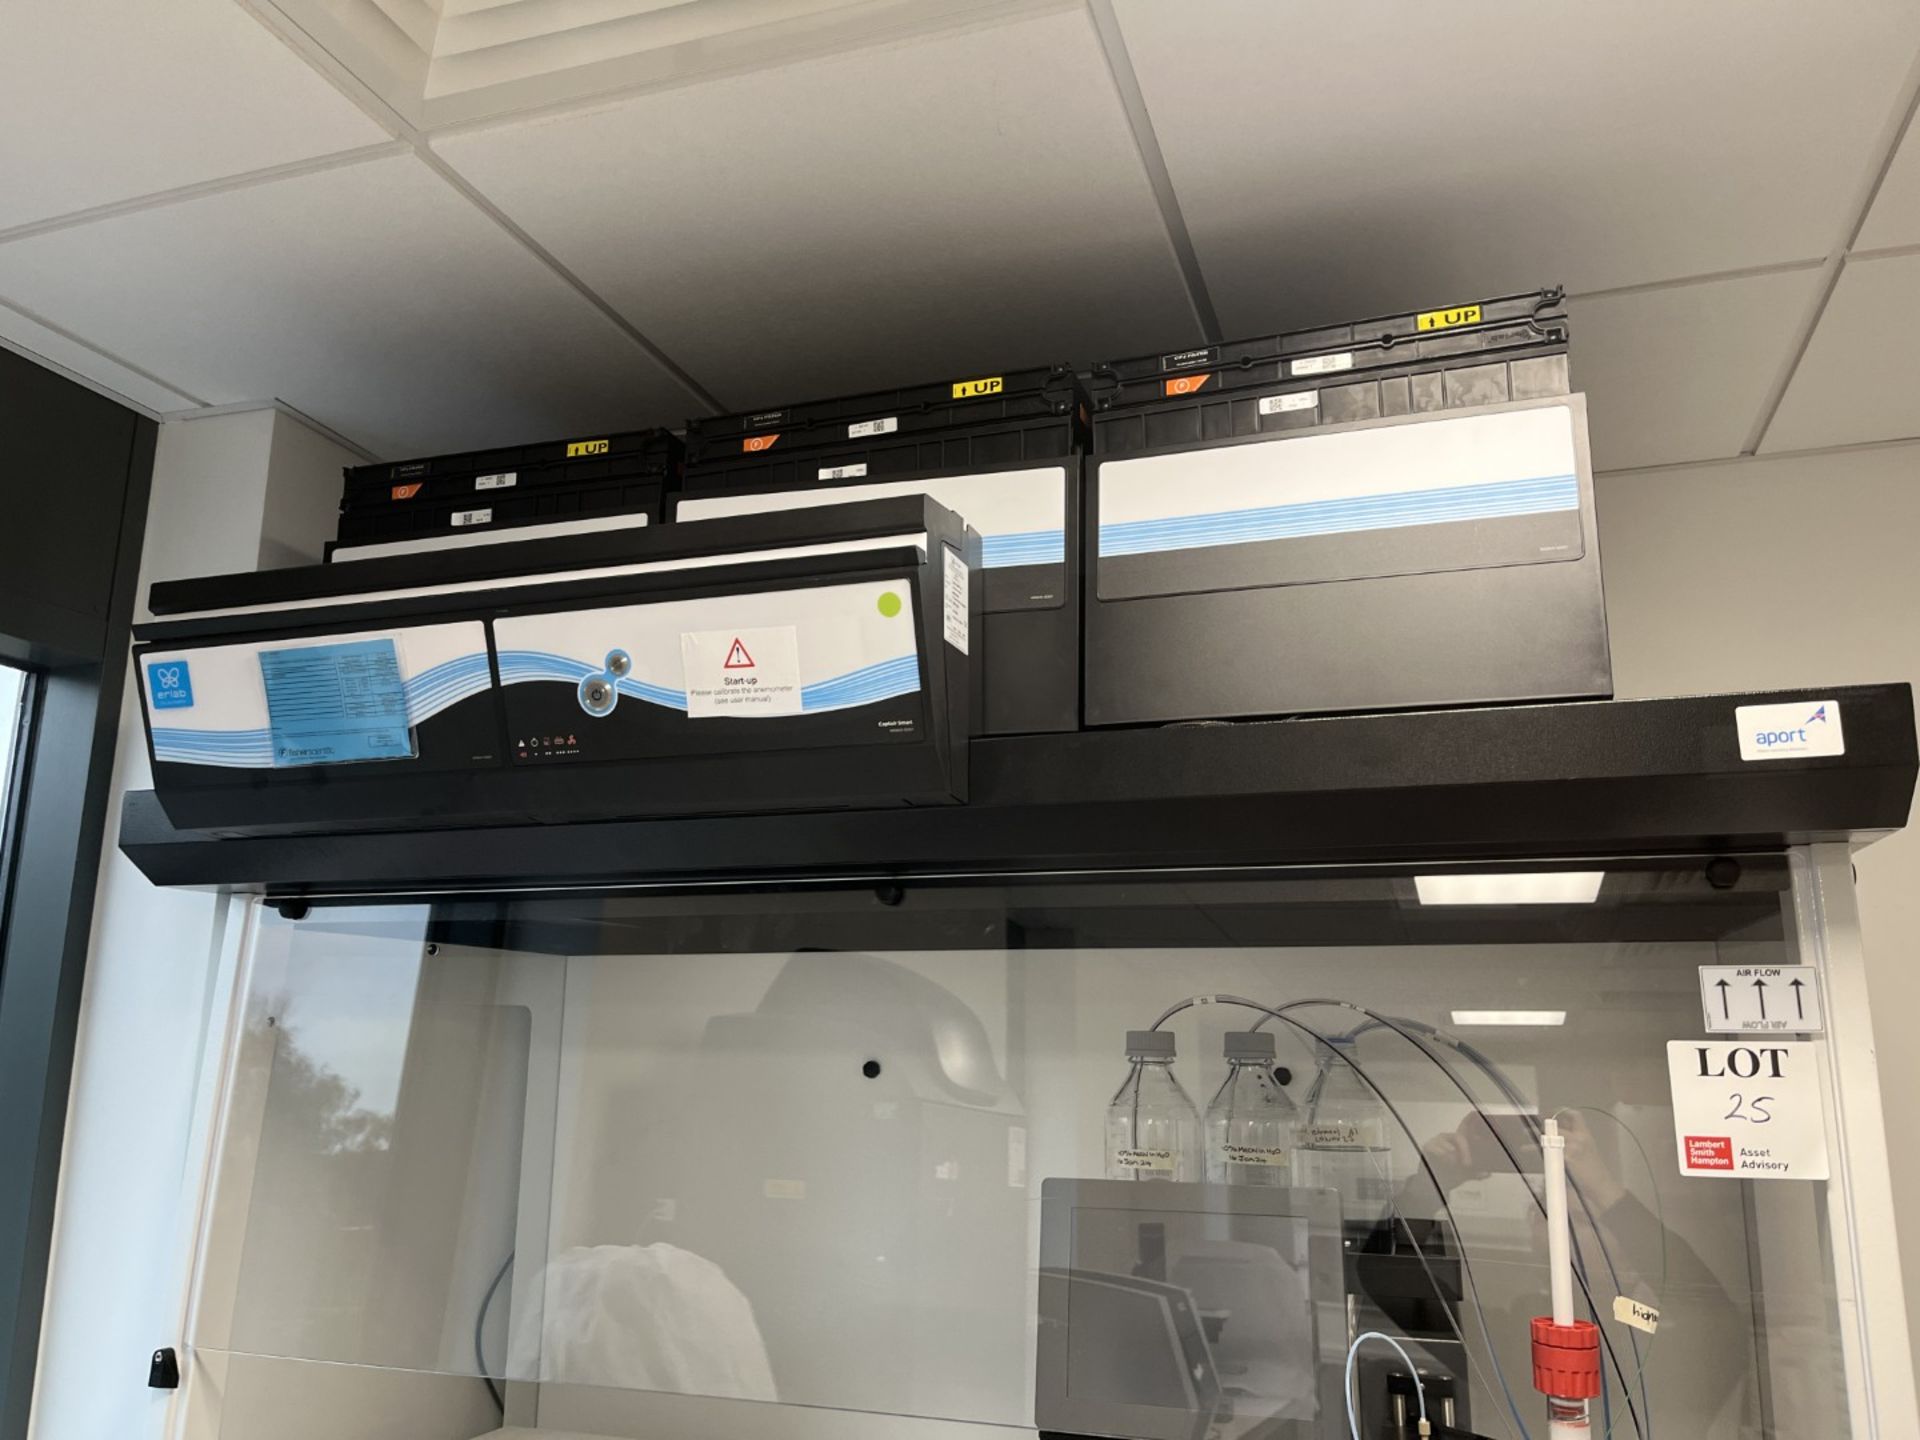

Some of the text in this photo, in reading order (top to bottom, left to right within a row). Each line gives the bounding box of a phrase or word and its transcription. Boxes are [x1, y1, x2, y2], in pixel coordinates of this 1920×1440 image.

[1444, 310, 1476, 324] UP
[974, 380, 1000, 393] UP
[585, 442, 607, 453] UP
[724, 677, 758, 686] Start-up
[157, 689, 187, 699] erlab
[741, 686, 752, 694] the
[1756, 728, 1807, 746] aport
[1742, 1020, 1787, 1029] AIR FLOW
[1695, 1048, 1789, 1078] LOT
[1724, 1093, 1775, 1123] 25
[1689, 1140, 1725, 1148] Lambert
[1690, 1148, 1715, 1156] Smith
[1740, 1148, 1770, 1157] Asset
[1691, 1156, 1729, 1165] Hampton
[1741, 1160, 1789, 1171] Advisory
